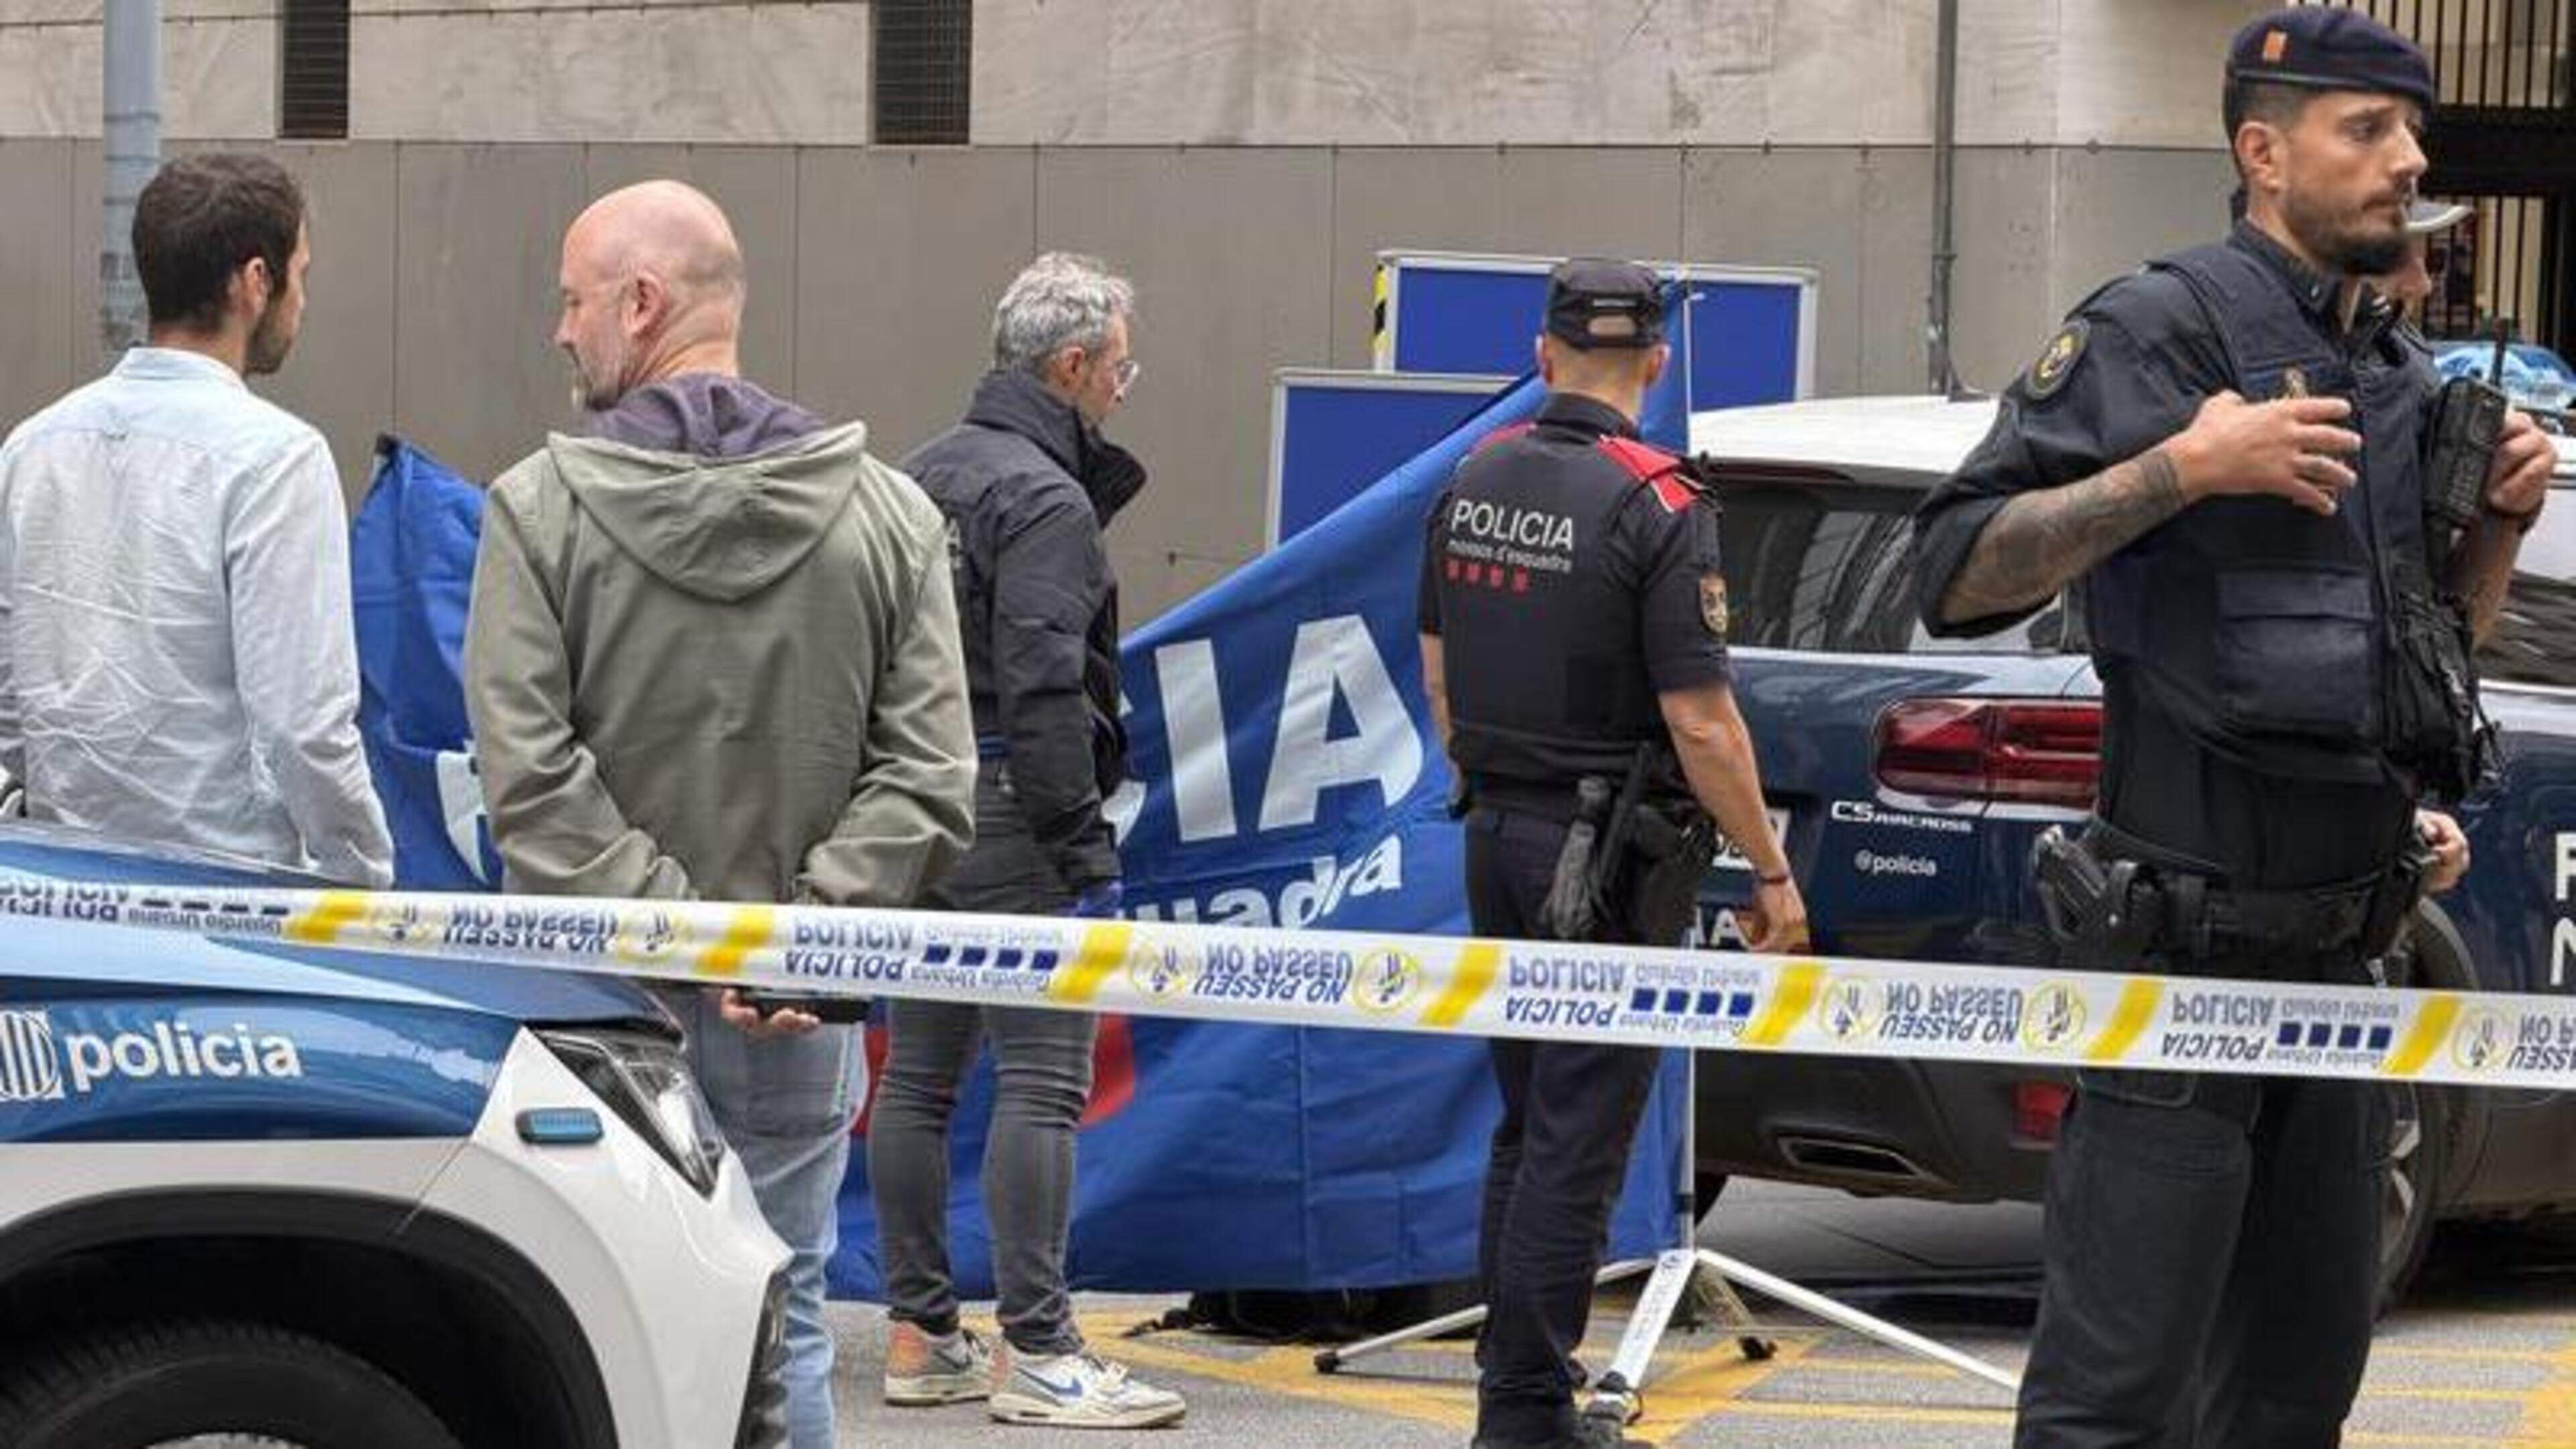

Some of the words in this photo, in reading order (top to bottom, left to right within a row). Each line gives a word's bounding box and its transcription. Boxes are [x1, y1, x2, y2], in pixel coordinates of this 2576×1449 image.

[1451, 498, 1573, 551] POLICIA
[1854, 849, 1937, 875] @policia
[784, 950, 906, 980] POLICIA
[1193, 975, 1298, 1000] PASSEU
[1306, 979, 1349, 1004] NO
[1505, 998, 1619, 1028] POLICIA
[1879, 1014, 1978, 1040] PASSEU
[1982, 1018, 2020, 1042] NO
[65, 1020, 303, 1092] policia
[2160, 1032, 2267, 1061] POLICIA
